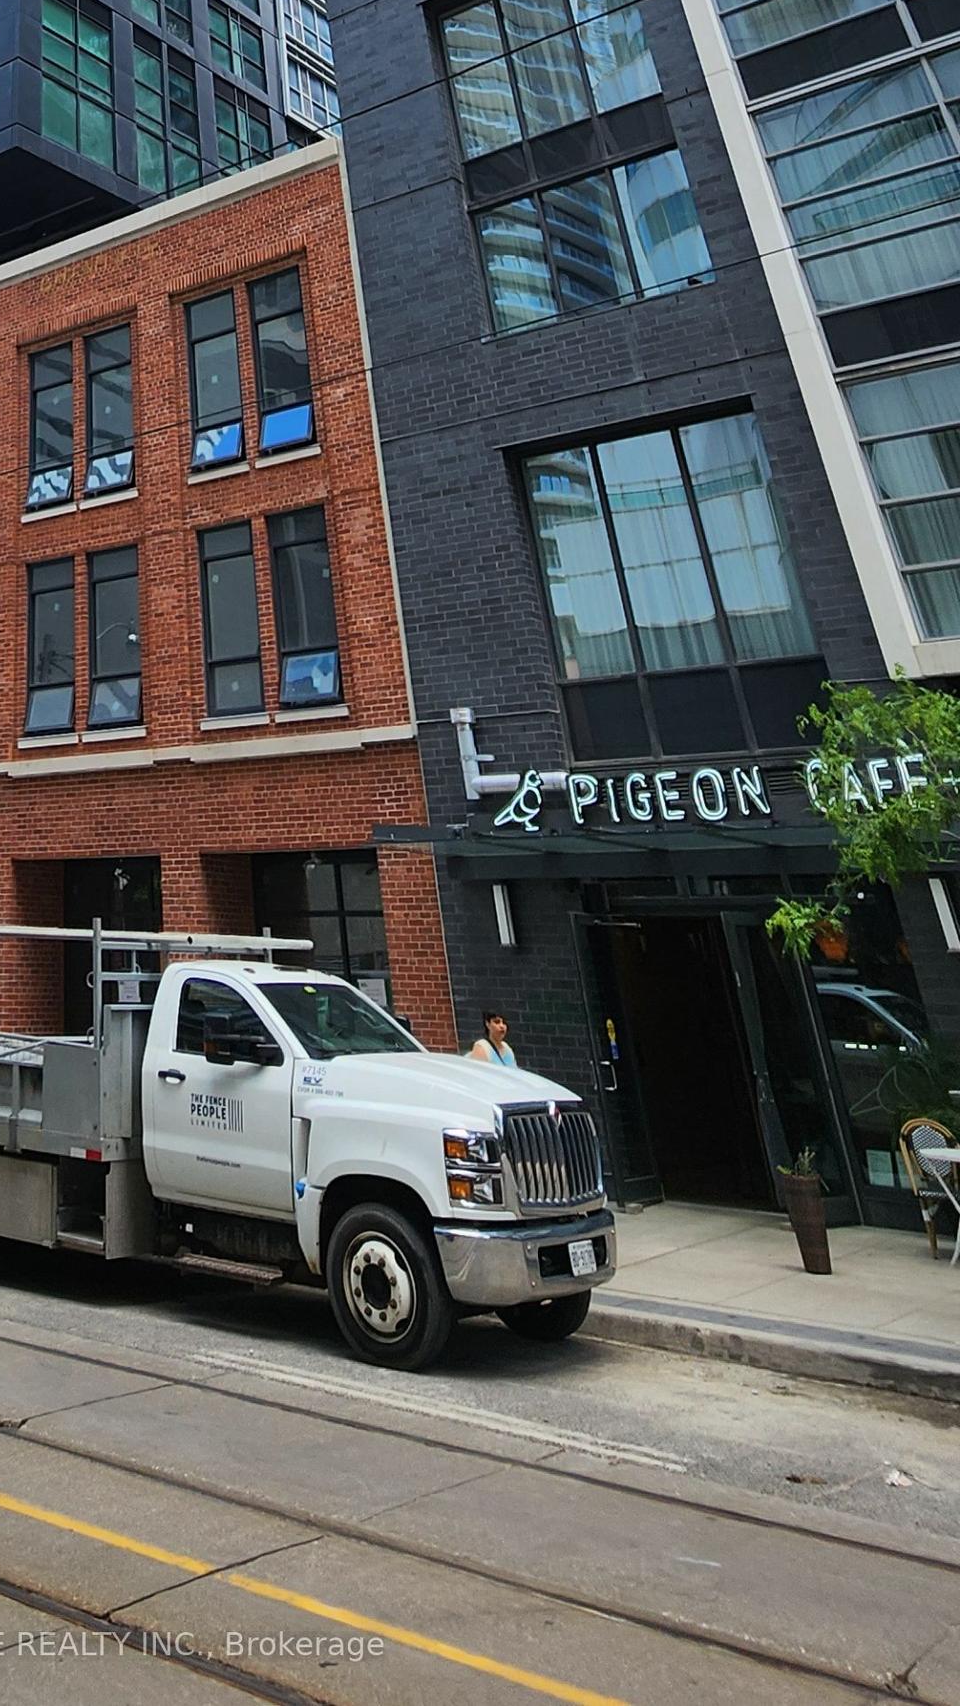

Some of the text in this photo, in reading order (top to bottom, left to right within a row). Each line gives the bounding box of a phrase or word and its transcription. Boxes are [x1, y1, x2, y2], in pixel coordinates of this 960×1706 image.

[567, 765, 772, 825] PIGEON
[190, 1093, 227, 1107] THE FENCE
[190, 1103, 227, 1120] PEOPLE
[190, 1119, 228, 1131] LIMITED
